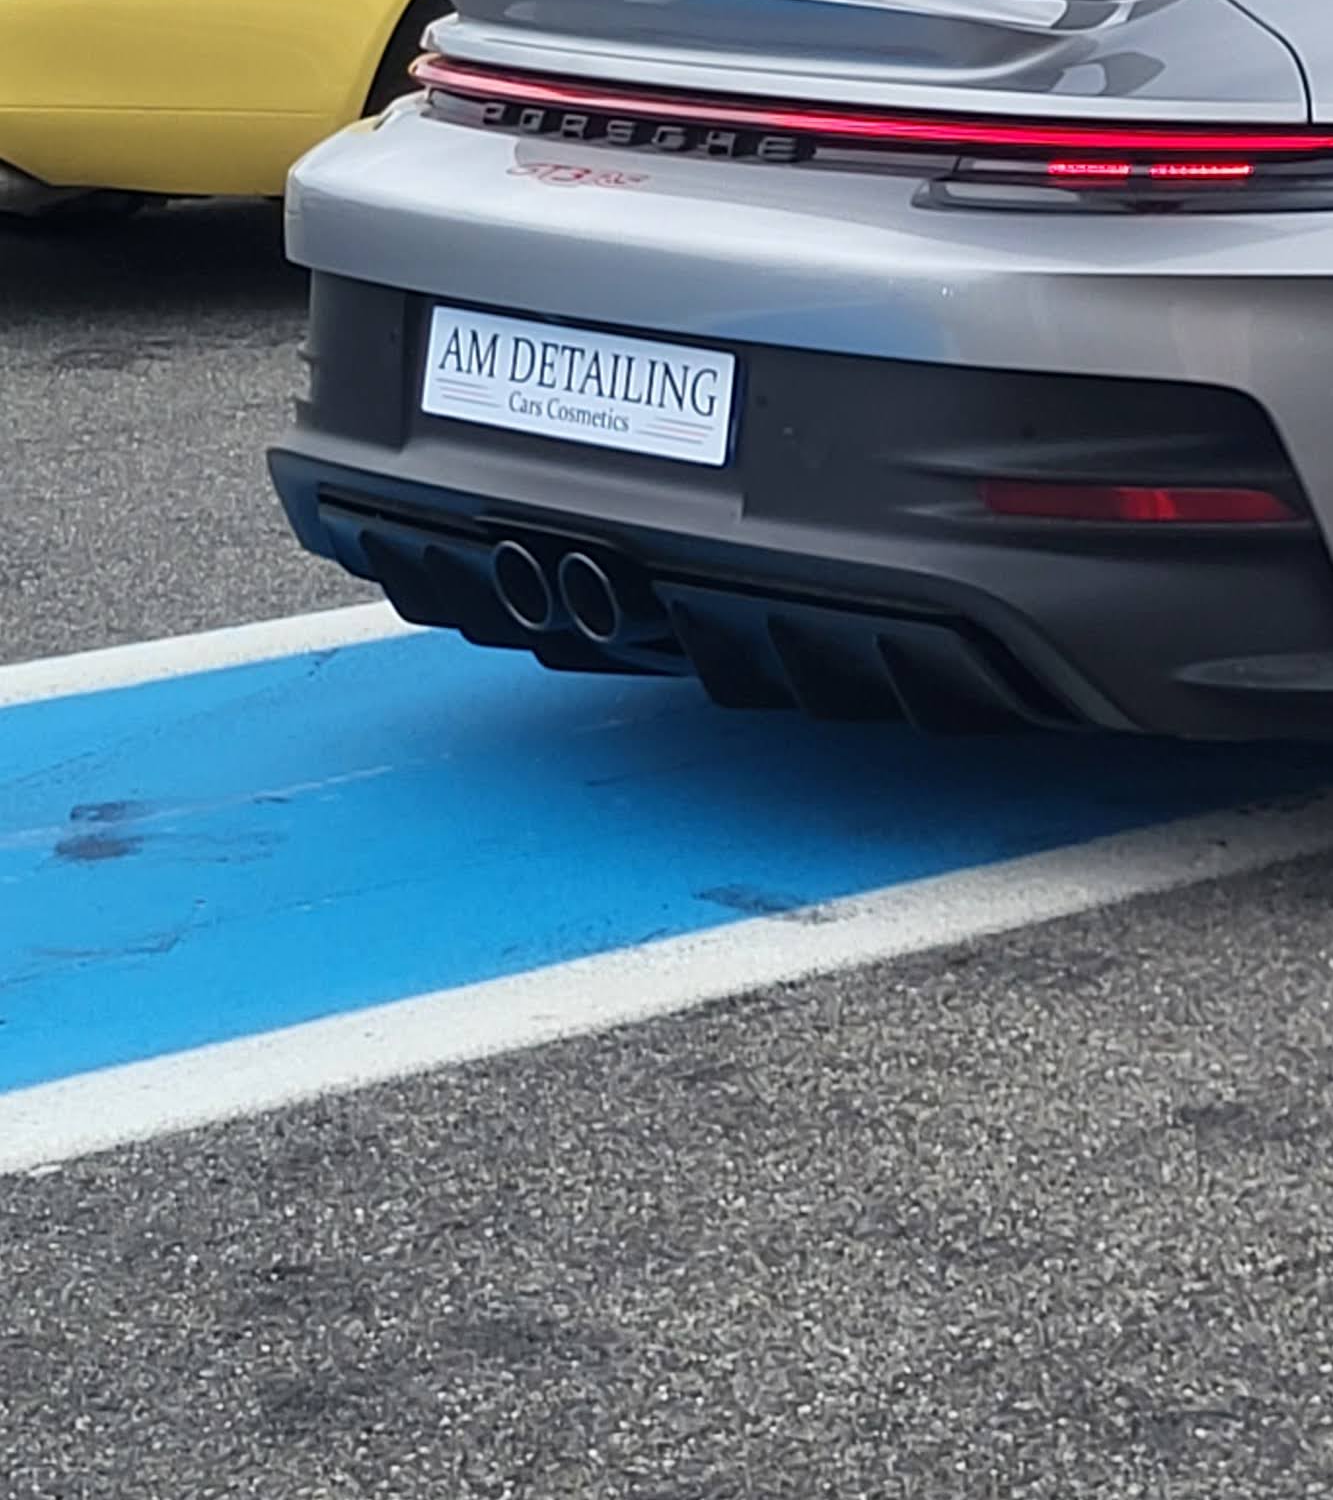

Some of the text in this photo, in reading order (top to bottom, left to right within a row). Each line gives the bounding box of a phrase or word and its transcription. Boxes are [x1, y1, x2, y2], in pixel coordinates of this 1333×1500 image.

[483, 102, 798, 162] PORSCHE
[438, 326, 719, 418] AM DETAILING
[508, 391, 630, 432] Cars Cosmetics
